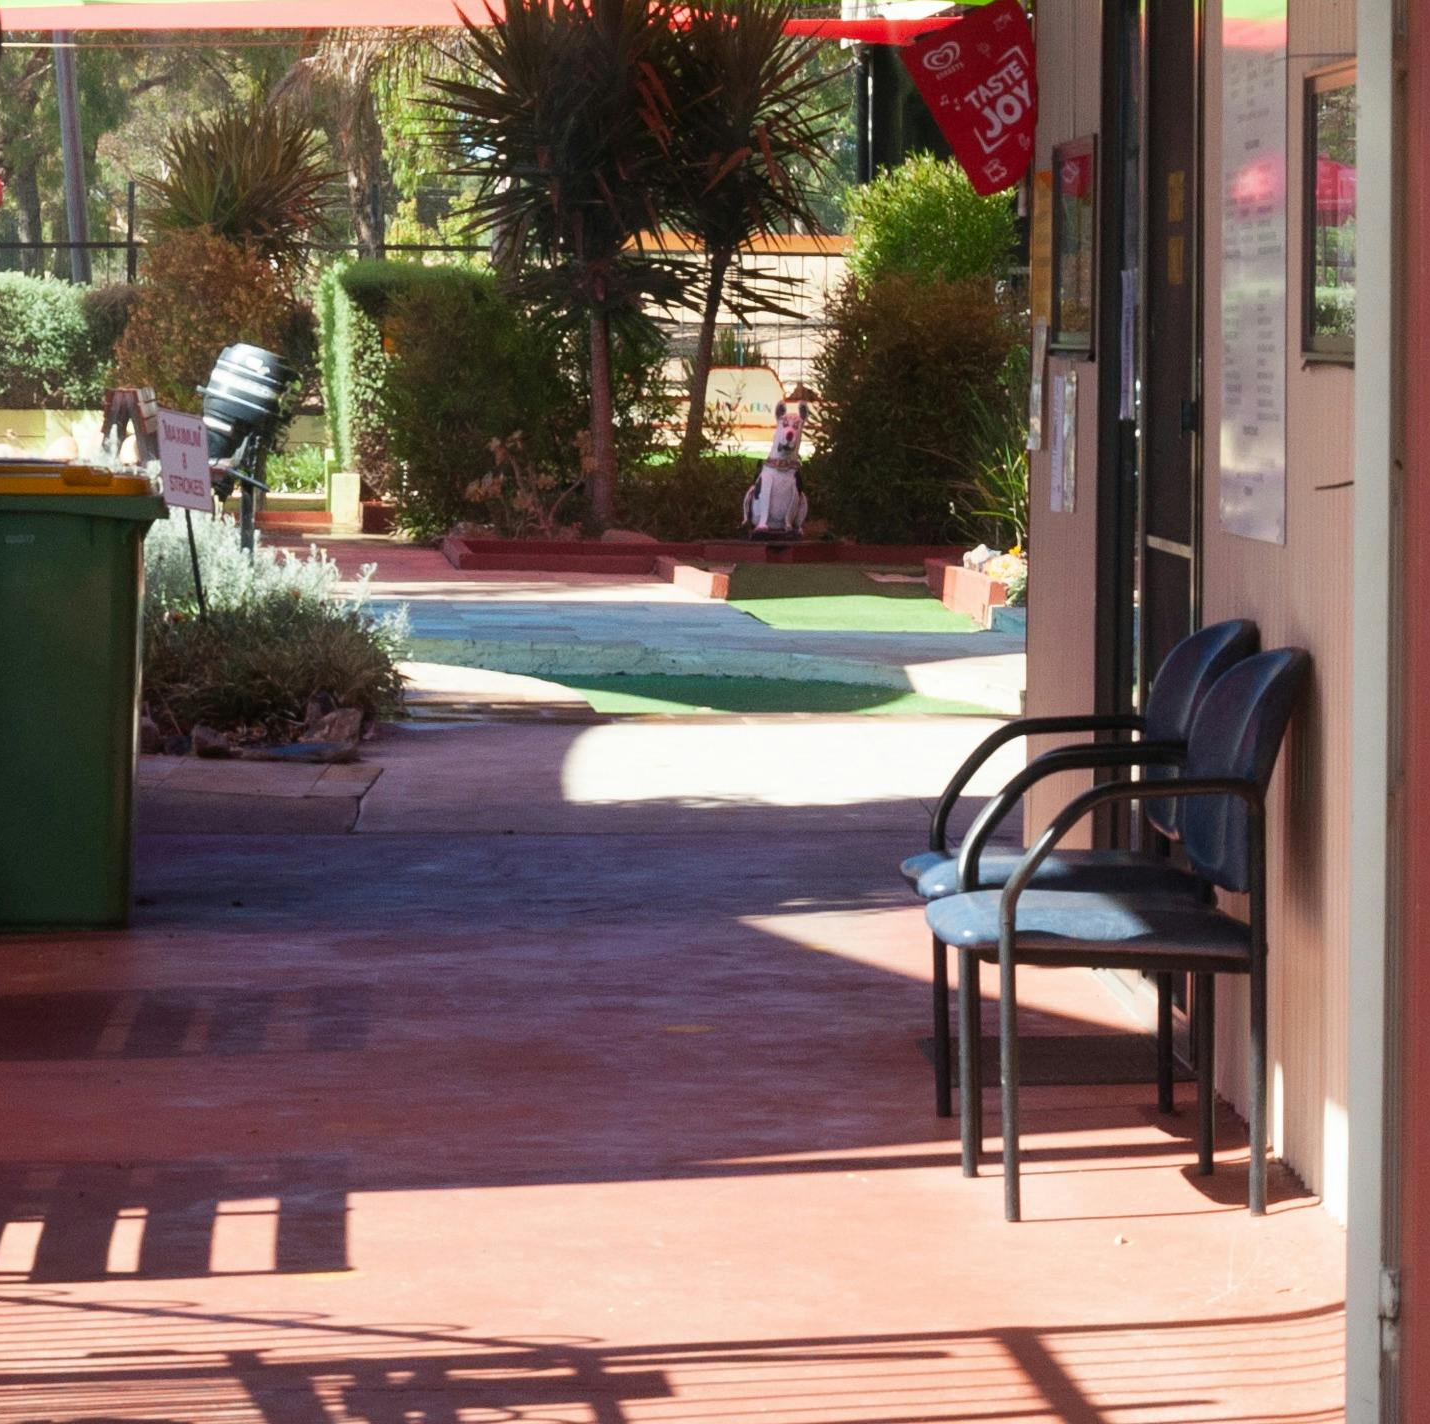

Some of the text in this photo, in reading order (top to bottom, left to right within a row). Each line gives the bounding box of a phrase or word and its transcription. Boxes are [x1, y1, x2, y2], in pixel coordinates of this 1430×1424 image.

[963, 59, 1024, 110] TASTE
[982, 78, 1032, 138] JOY
[169, 474, 205, 497] STROKES
